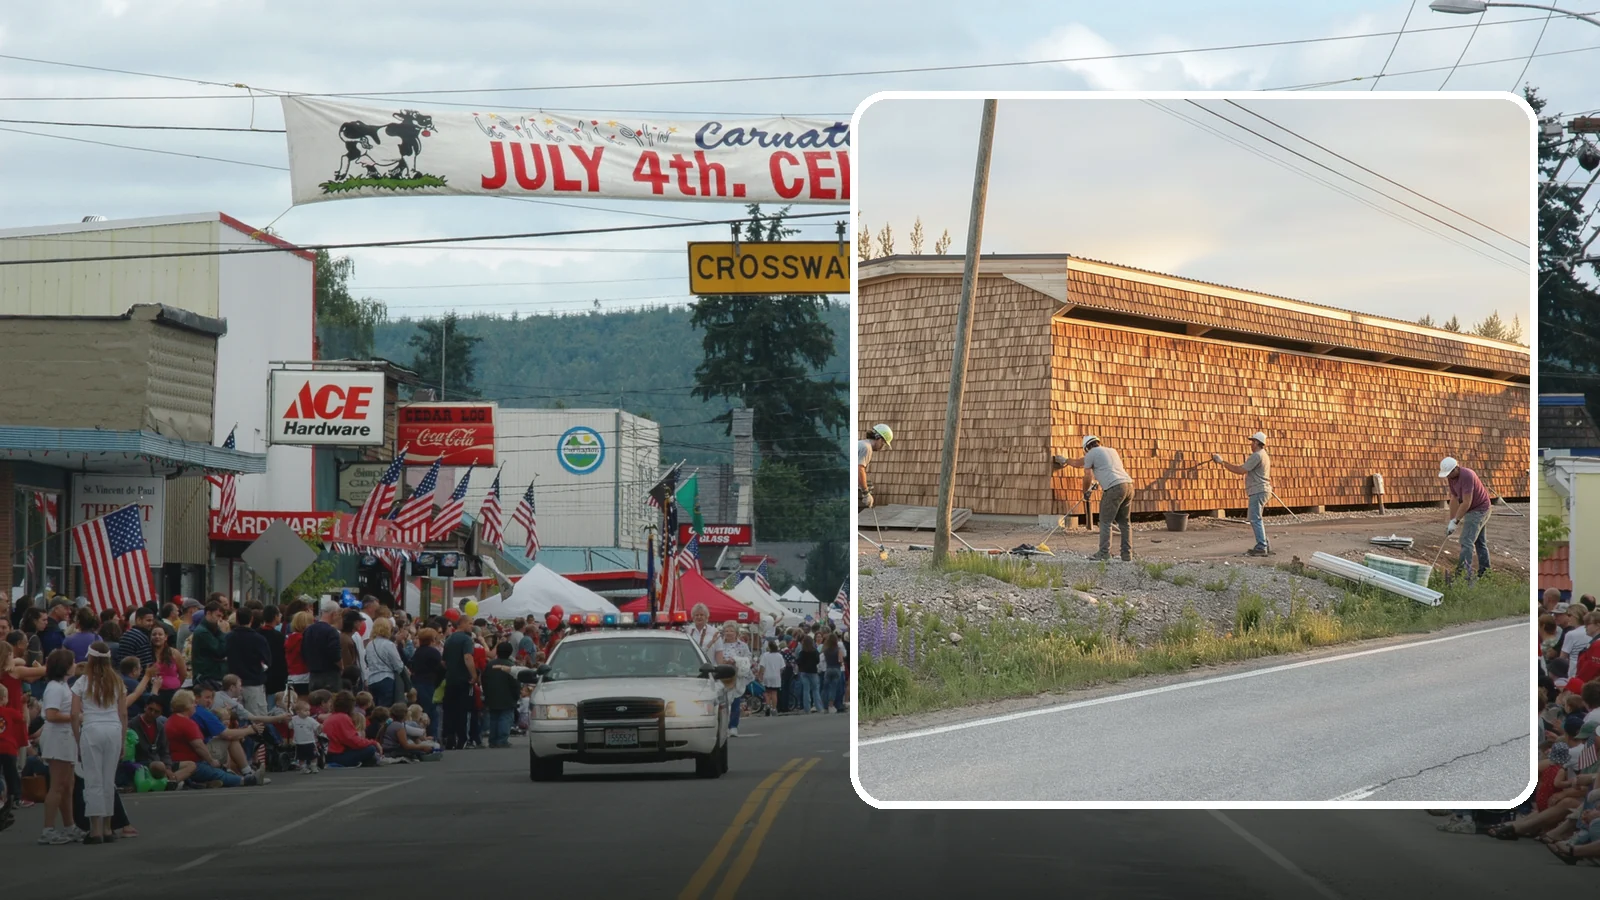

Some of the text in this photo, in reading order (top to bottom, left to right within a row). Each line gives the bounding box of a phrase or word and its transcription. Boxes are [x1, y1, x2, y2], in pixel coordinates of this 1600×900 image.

[481, 141, 604, 192] JULY
[632, 150, 747, 197] 4th.
[697, 254, 850, 280] CROSSWA
[282, 380, 374, 420] ACE
[406, 409, 453, 422] CEDAR
[283, 421, 371, 437] Hardware
[416, 428, 477, 447] Coca-Cola
[353, 467, 387, 480] Simpl
[83, 485, 155, 495] St. Vincent de Paul
[213, 516, 331, 535] HARDARE
[688, 526, 741, 535] CRNATION
[699, 535, 730, 543] GLASS
